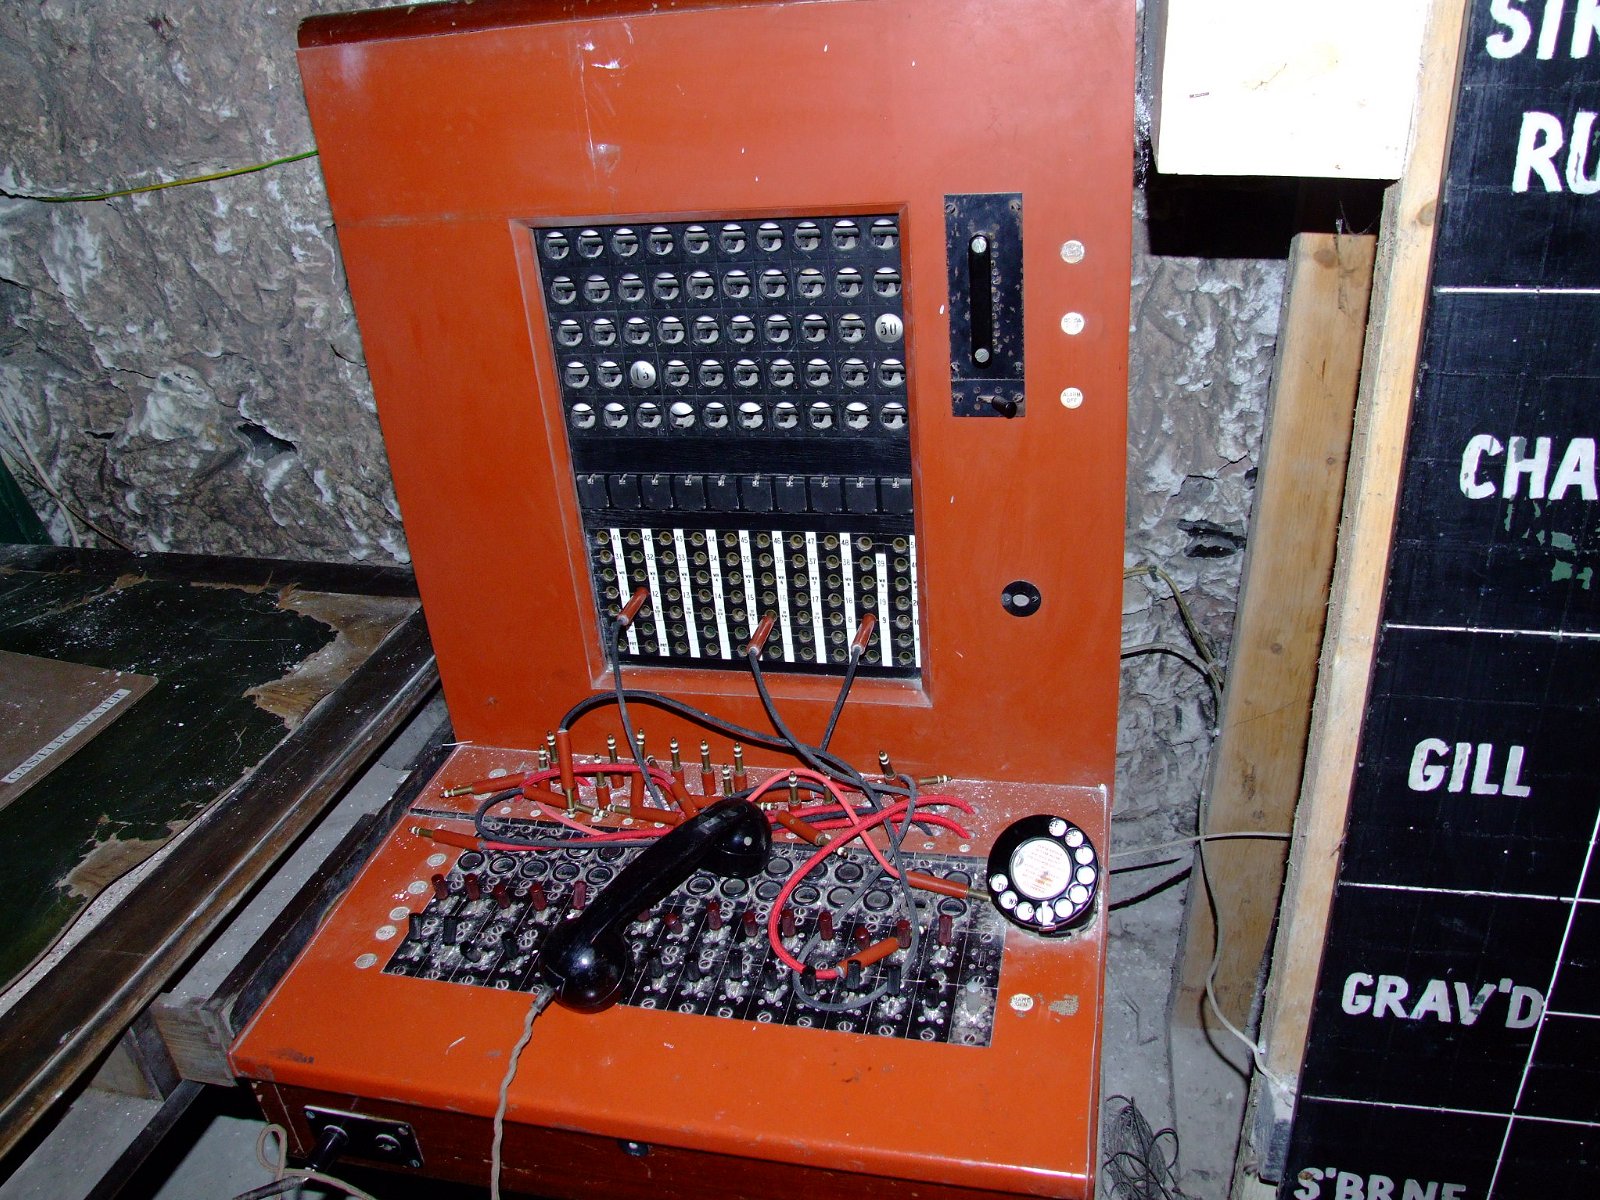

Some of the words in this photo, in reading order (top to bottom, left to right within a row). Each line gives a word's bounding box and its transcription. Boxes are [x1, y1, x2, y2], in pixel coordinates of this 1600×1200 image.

[880, 321, 897, 336] 30
[1408, 738, 1531, 797] GILL
[1342, 972, 1544, 1029] GRAV'D
